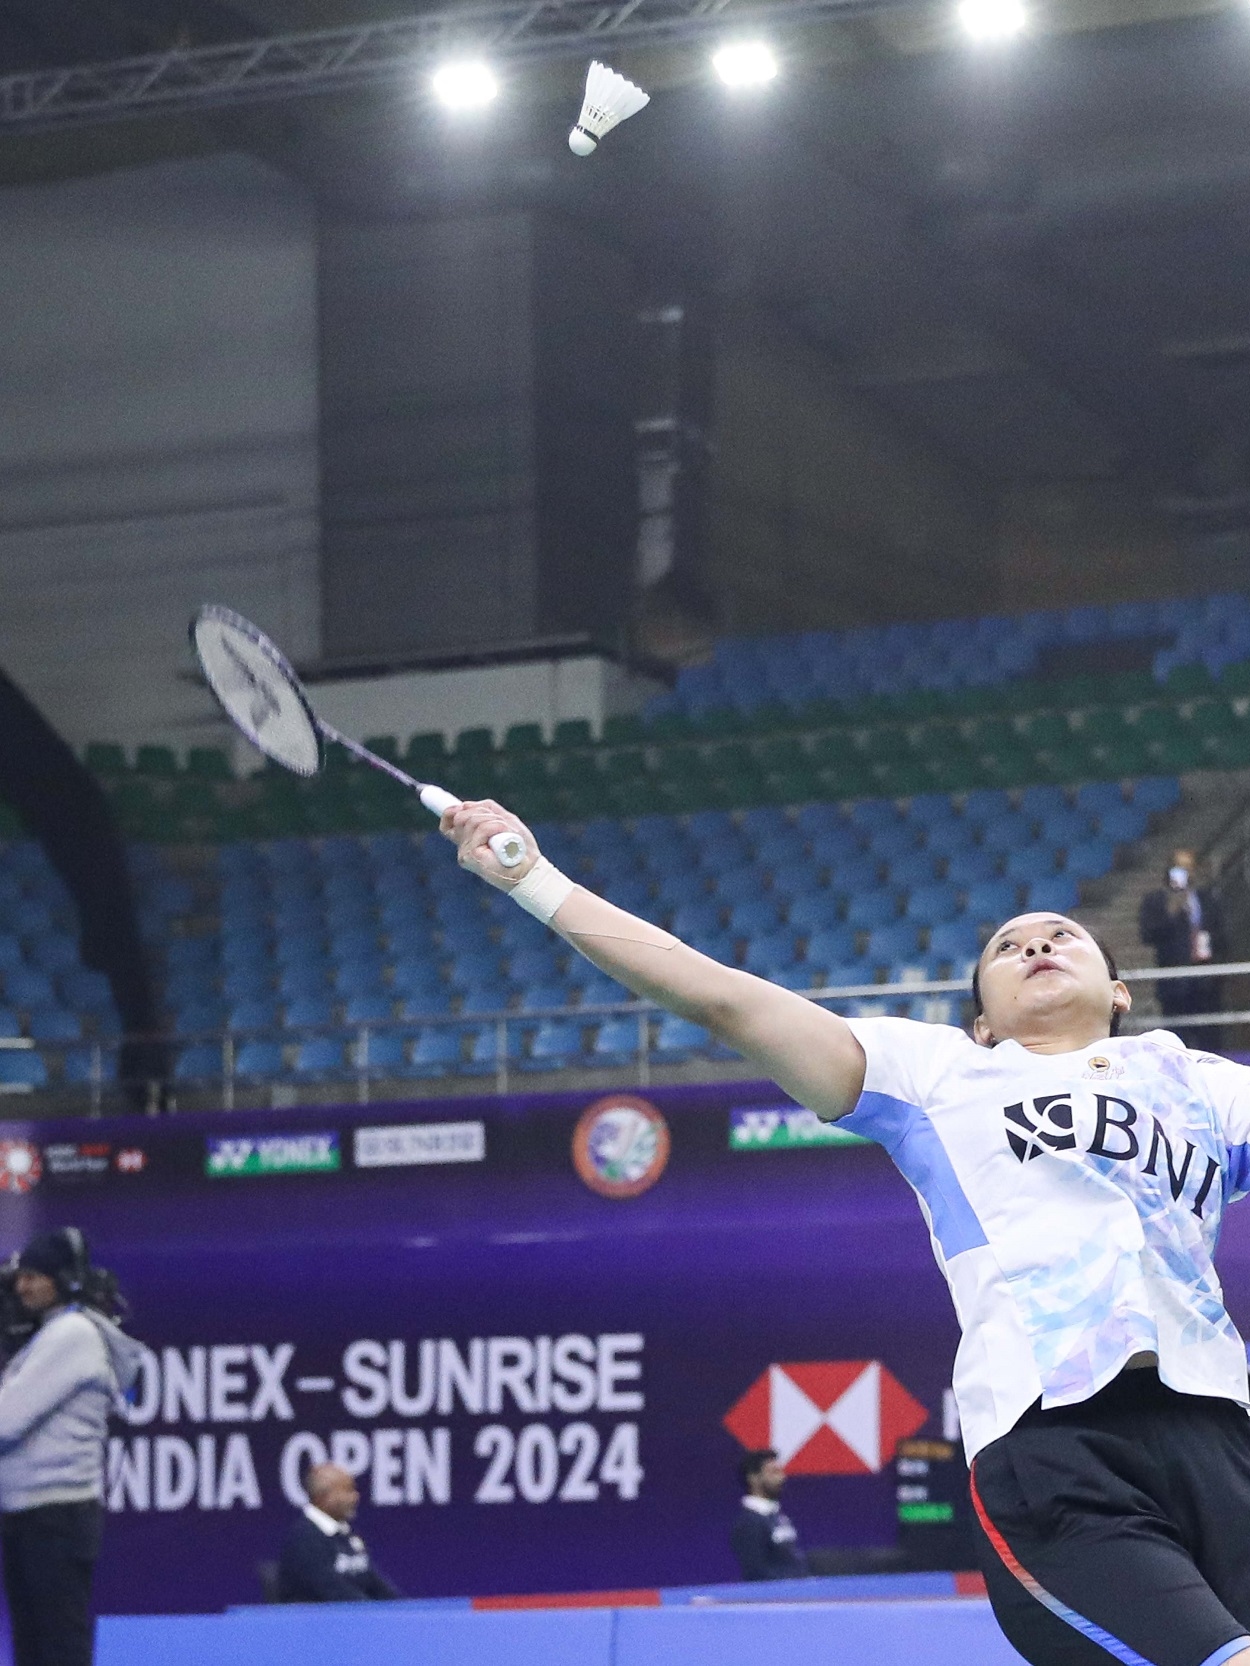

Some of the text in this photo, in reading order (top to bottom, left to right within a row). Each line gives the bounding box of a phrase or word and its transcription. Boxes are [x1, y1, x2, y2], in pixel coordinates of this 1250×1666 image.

[258, 1134, 333, 1169] YONEX
[1085, 1093, 1221, 1221] BNI
[107, 1421, 644, 1512] NDIA OPEN 2024
